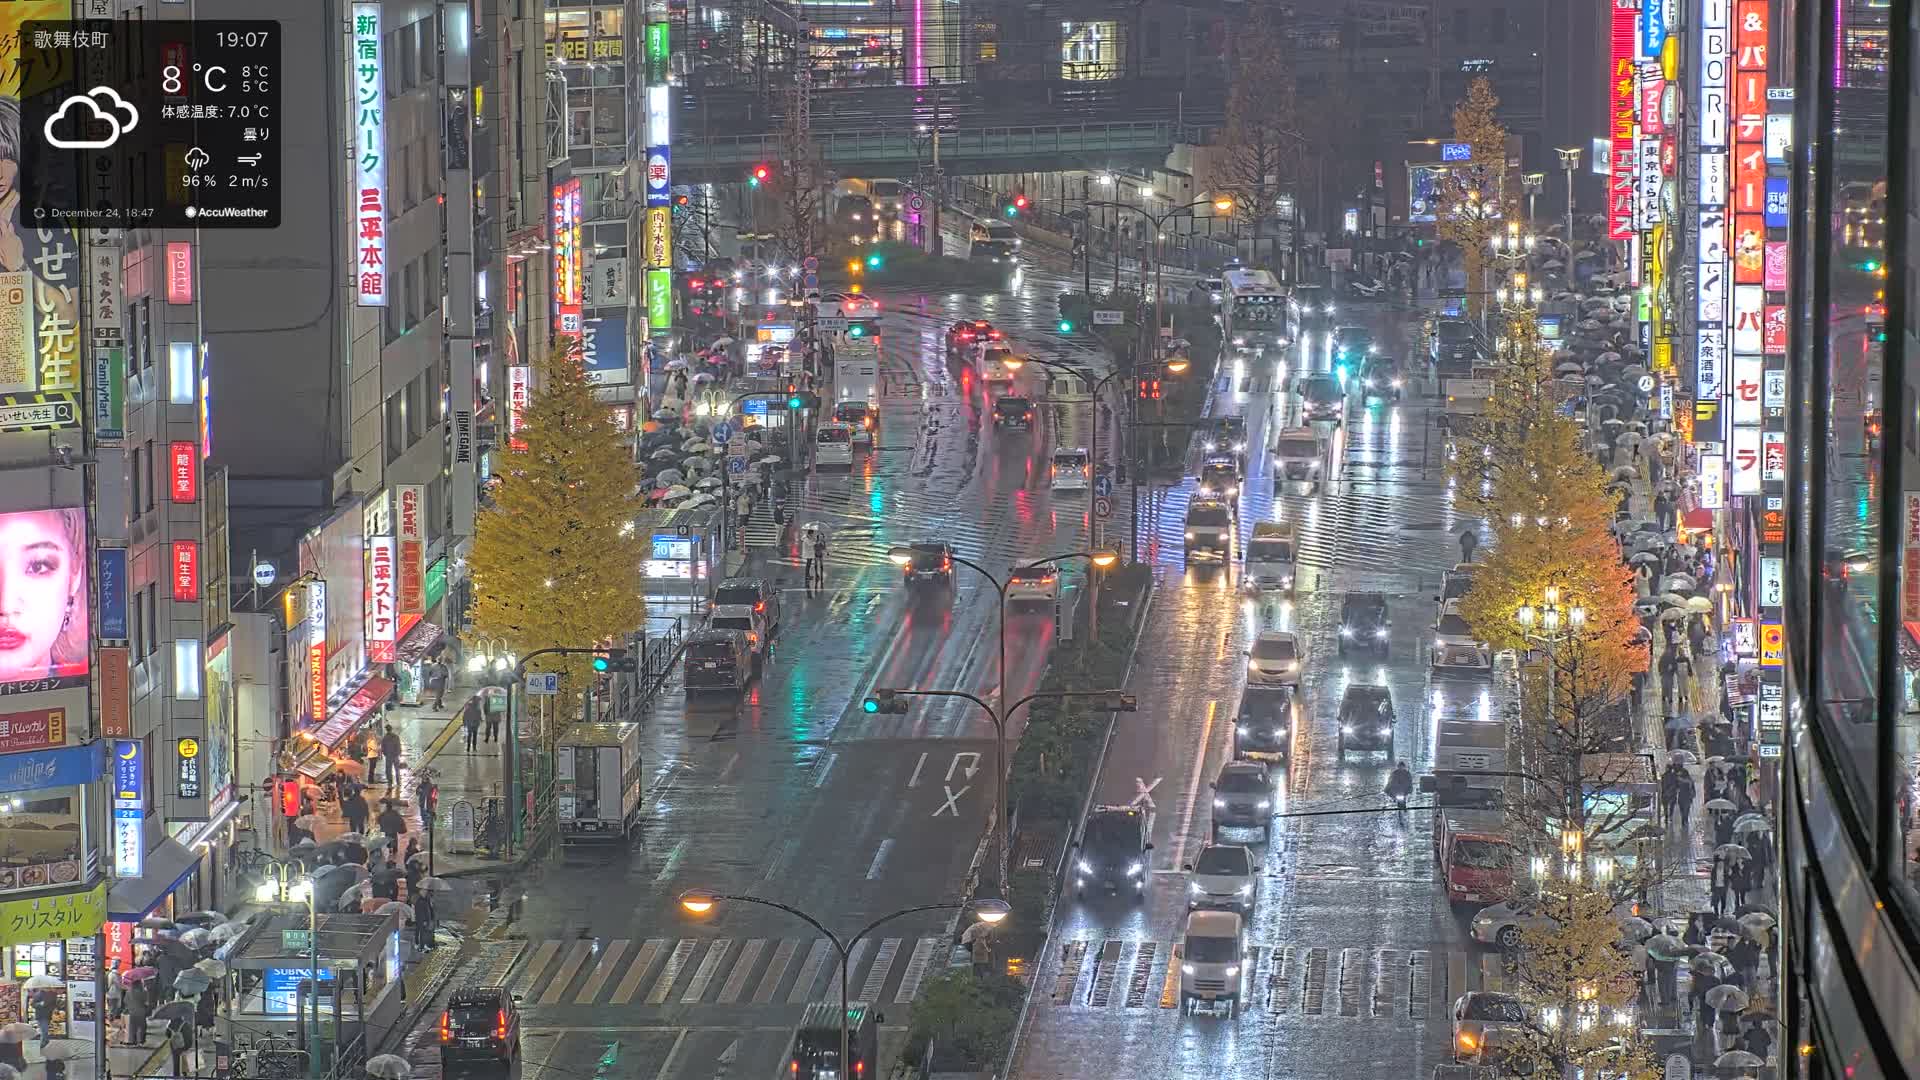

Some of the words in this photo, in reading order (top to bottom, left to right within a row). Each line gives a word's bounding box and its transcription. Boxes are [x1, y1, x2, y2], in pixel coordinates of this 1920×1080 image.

[357, 15, 380, 173] 新宿サンパーク
[1647, 91, 1659, 122] アコム
[360, 188, 383, 295] 三平本館
[98, 358, 109, 418] FamilyMart
[1701, 333, 1713, 384] 大衆酒場
[374, 547, 391, 632] 三平ストア
[11, 911, 83, 932] クリスタル
